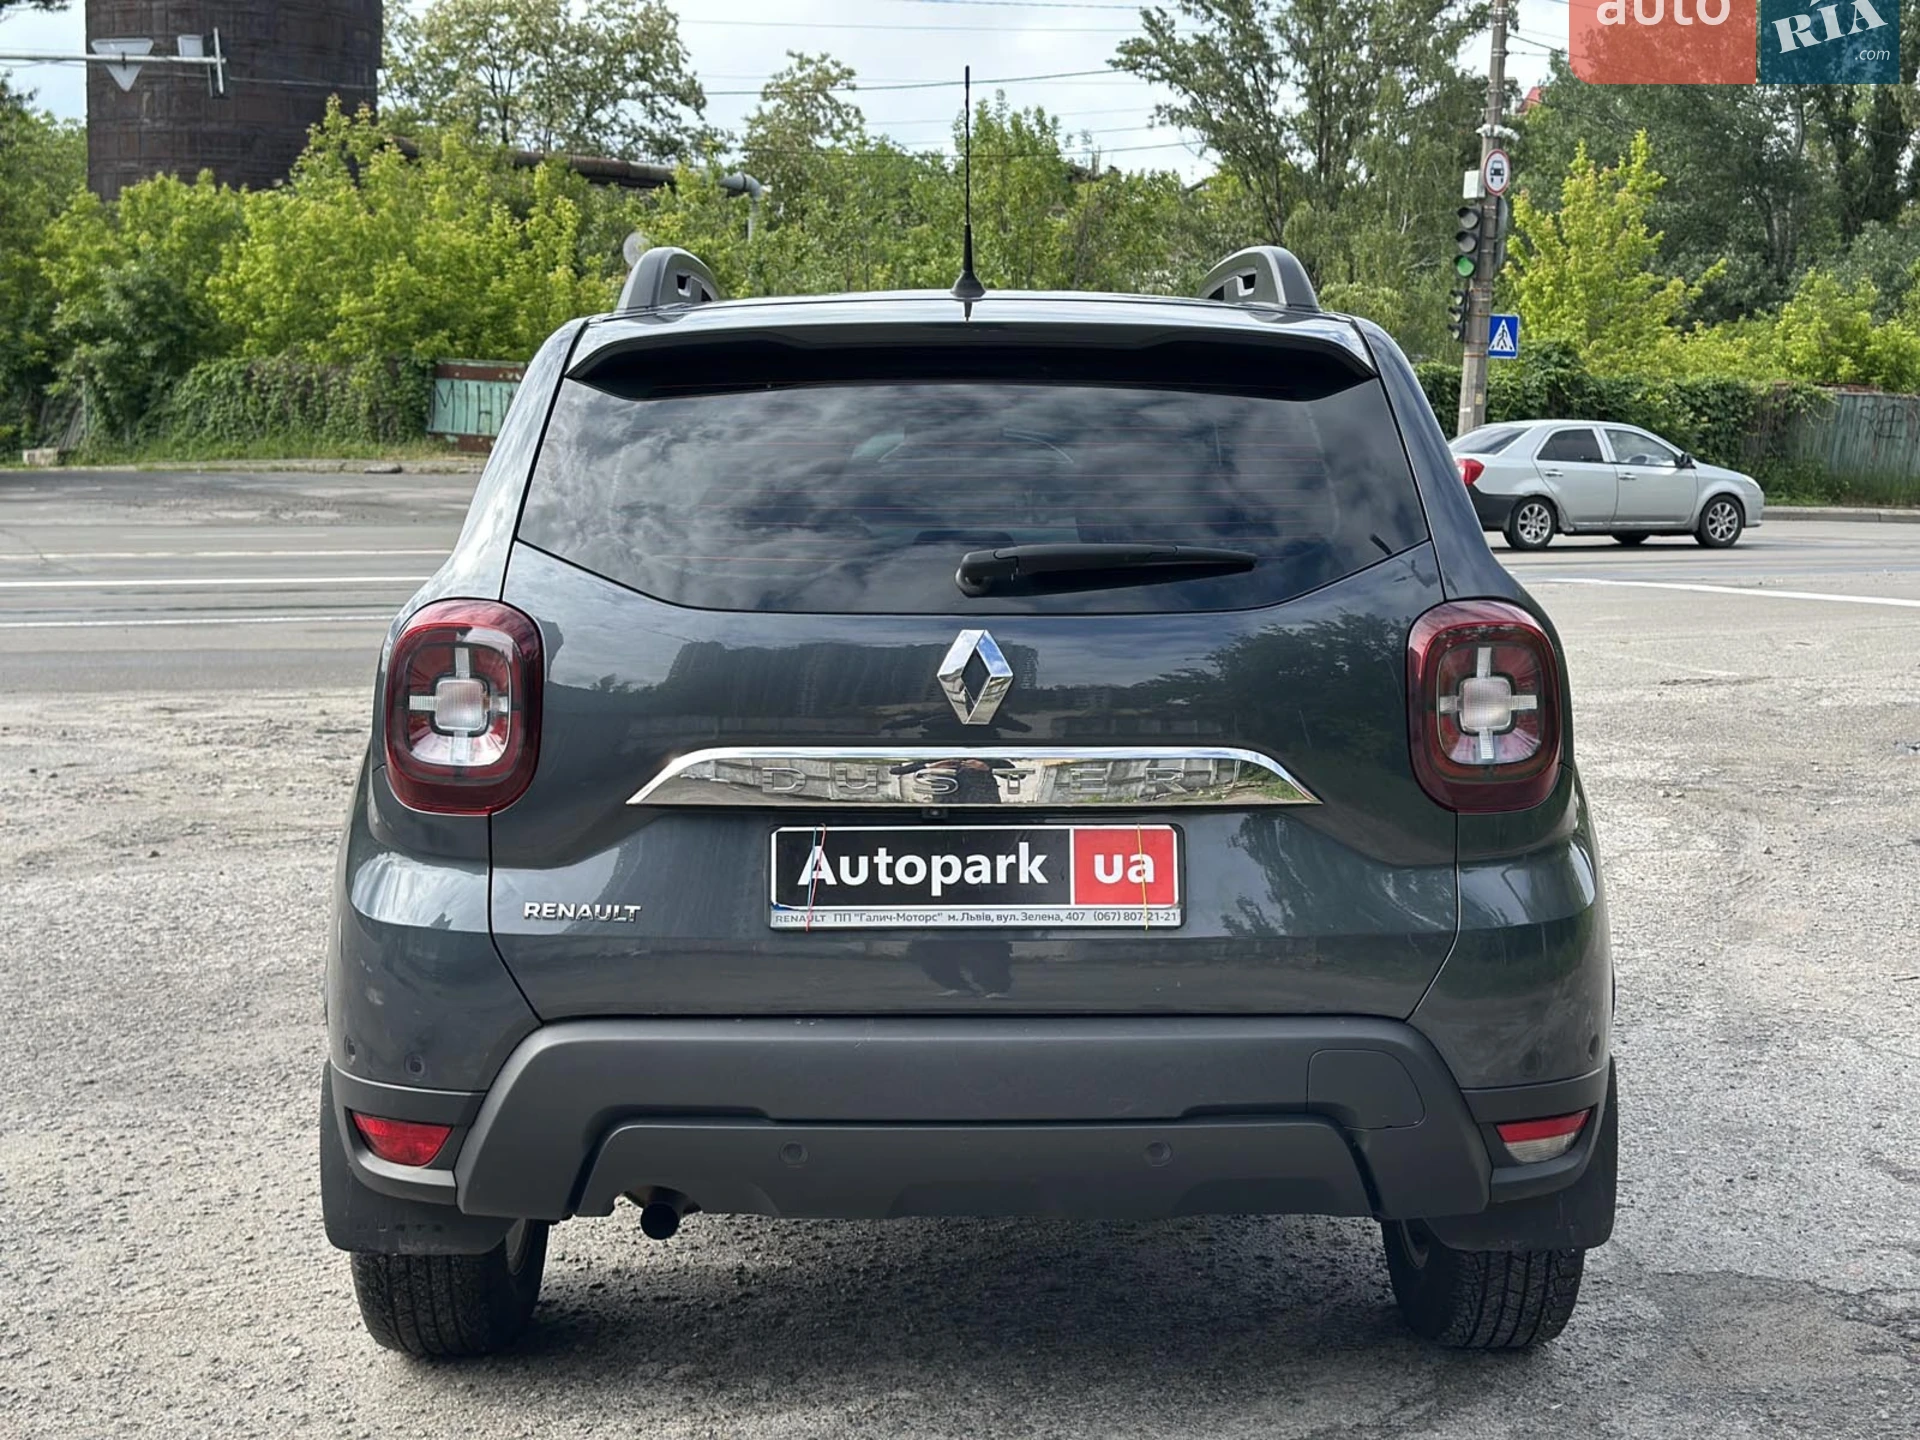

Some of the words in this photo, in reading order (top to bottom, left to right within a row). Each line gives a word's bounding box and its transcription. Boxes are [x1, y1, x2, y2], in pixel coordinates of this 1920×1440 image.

[762, 767, 1189, 795] DUSTER
[797, 842, 1049, 897] Autopark
[1093, 852, 1155, 884] ua
[523, 902, 642, 922] RENAULT
[775, 914, 826, 923] RENAULT
[833, 914, 851, 922] ПП
[854, 912, 943, 923] "Галич-Моторс"
[948, 913, 959, 921] м.
[961, 912, 994, 923] Львів,
[996, 912, 1019, 922] вул.
[1021, 912, 1063, 923] Зелена,
[1065, 912, 1085, 921] 407
[1093, 911, 1120, 922] (067)
[1123, 911, 1177, 922] 807-21-21
